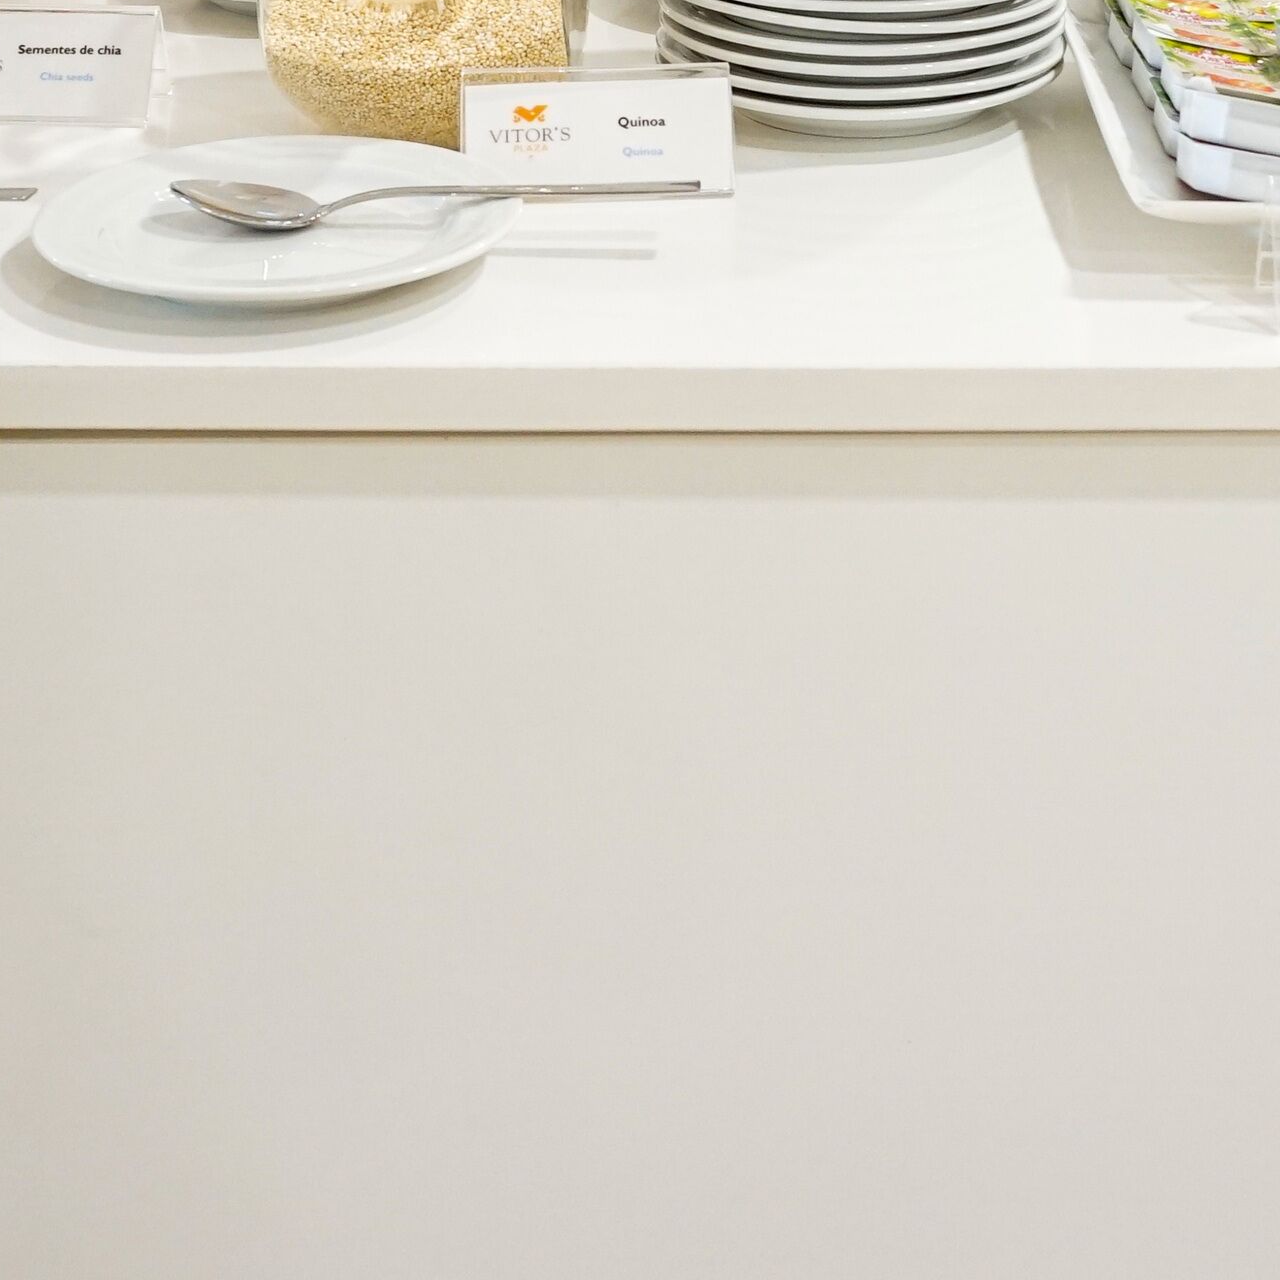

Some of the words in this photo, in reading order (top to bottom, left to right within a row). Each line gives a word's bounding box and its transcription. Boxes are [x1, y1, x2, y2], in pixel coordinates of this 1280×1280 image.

[17, 44, 76, 56] Sementes
[79, 44, 94, 56] de
[97, 44, 122, 56] chia
[617, 116, 666, 129] Quinoa
[489, 125, 571, 144] VITOR'S
[622, 146, 664, 158] Quinoa
